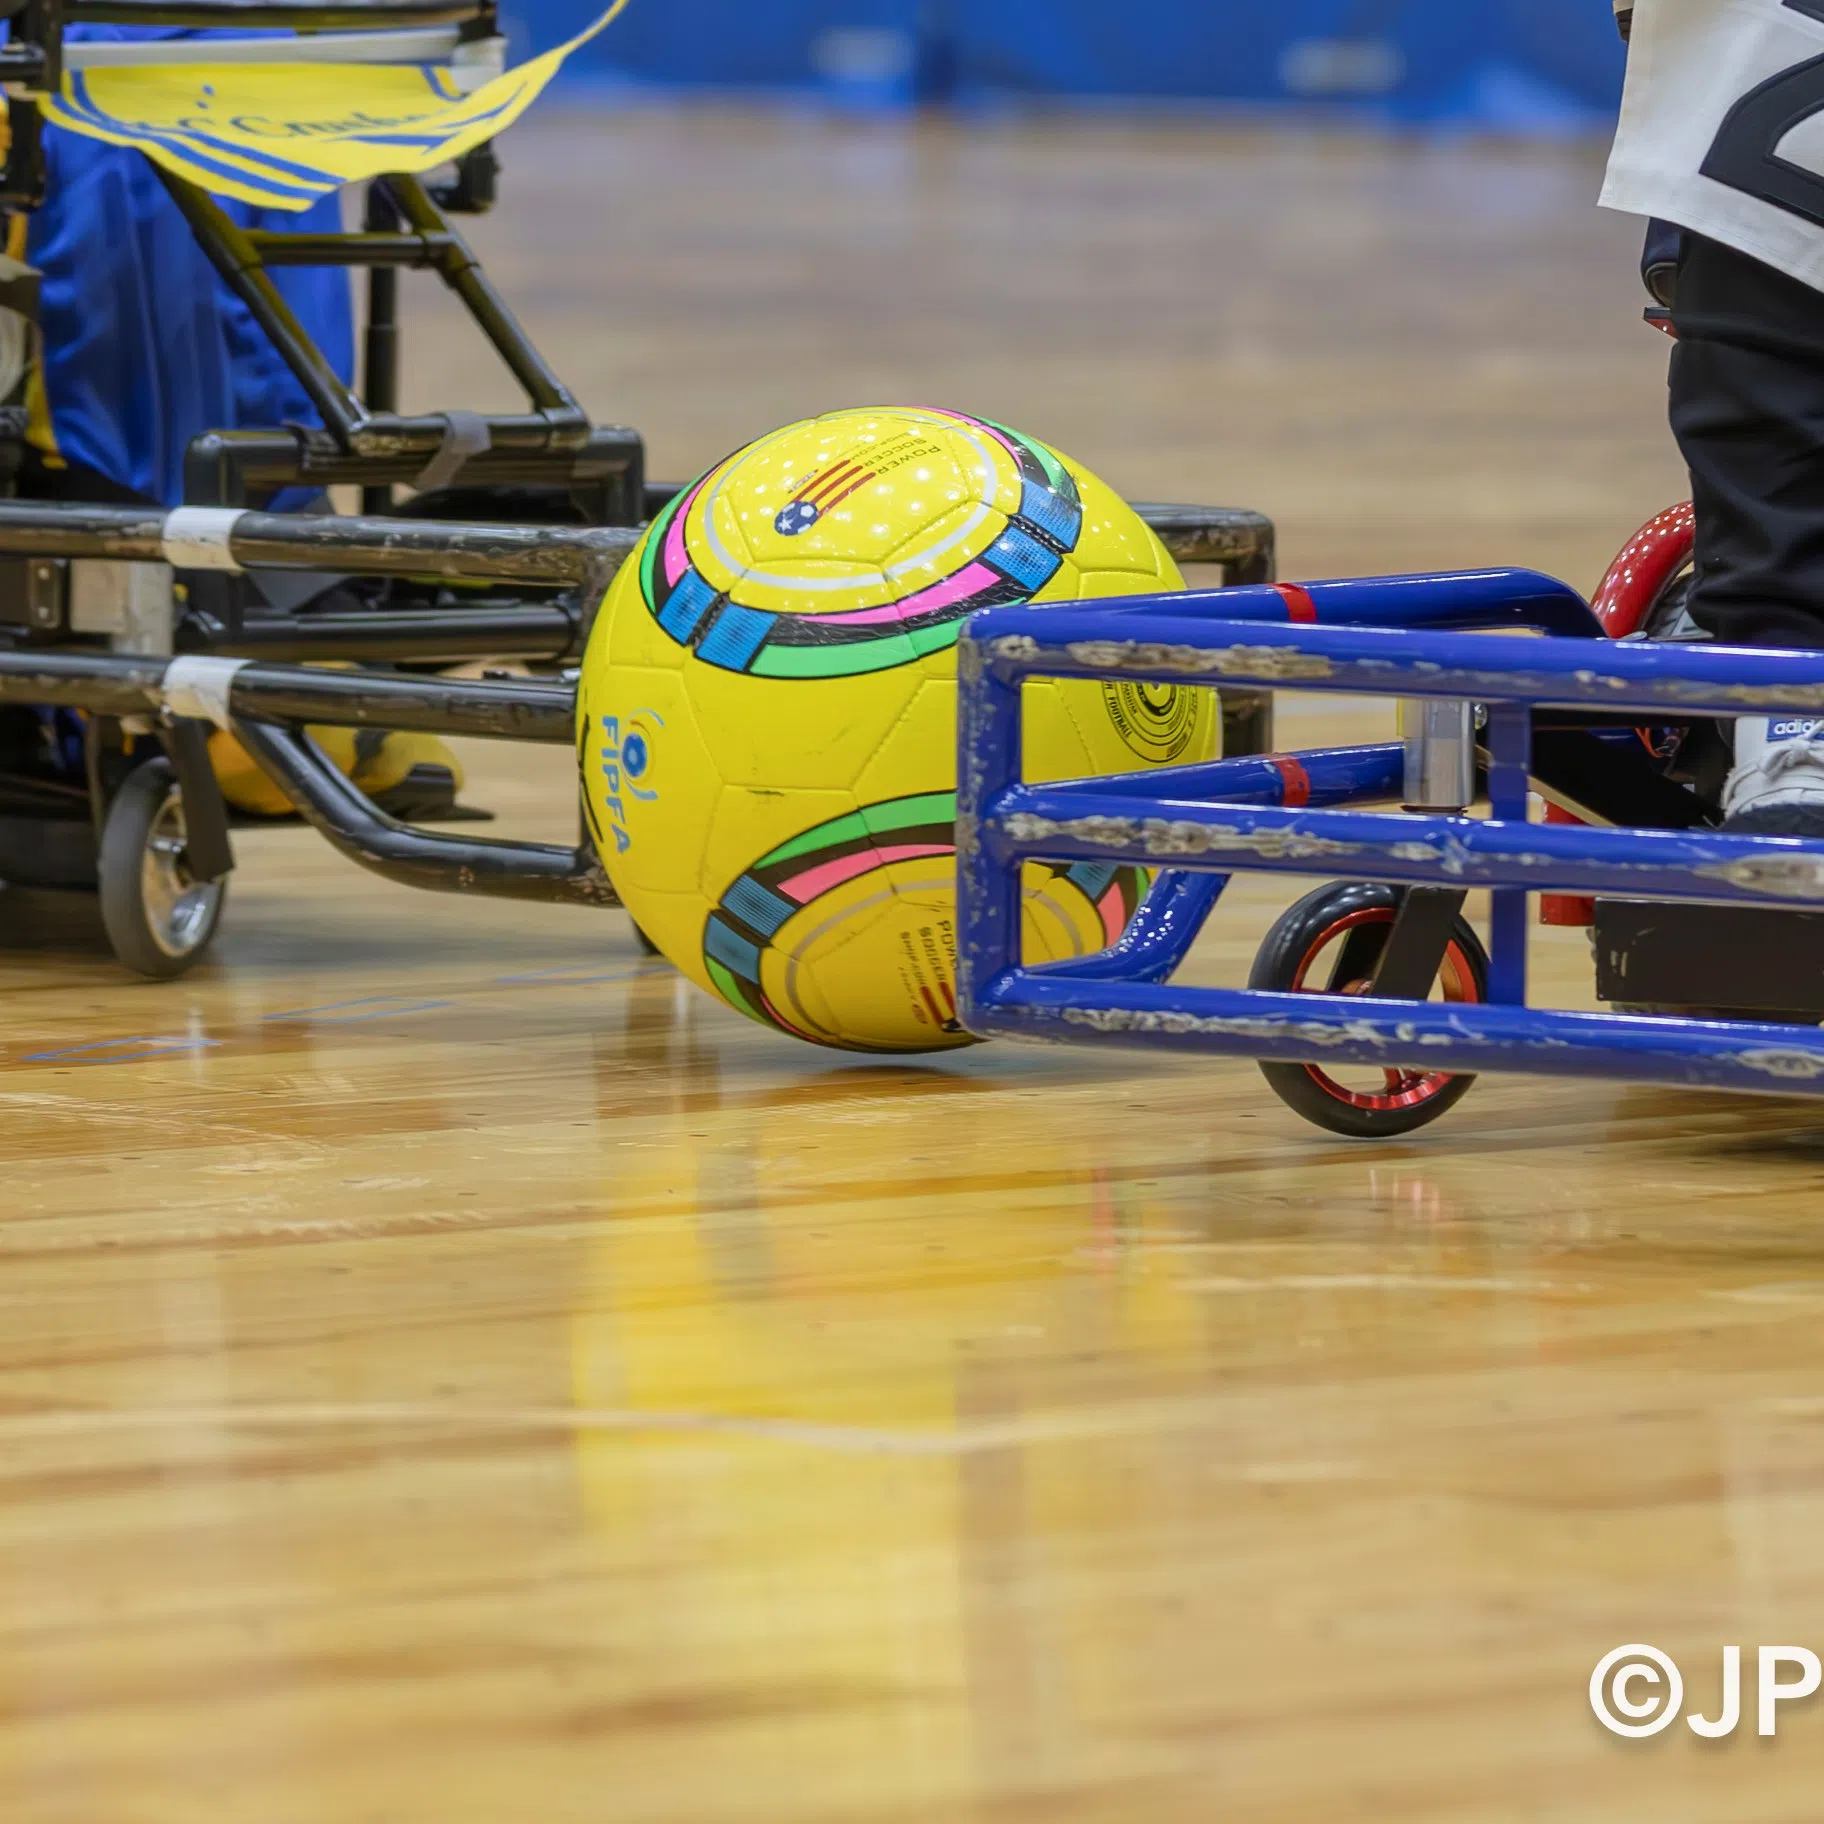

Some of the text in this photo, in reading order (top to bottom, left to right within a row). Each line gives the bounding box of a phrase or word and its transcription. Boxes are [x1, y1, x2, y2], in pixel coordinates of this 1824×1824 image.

[862, 437, 927, 467] SOCCER
[877, 444, 941, 475] POWER
[601, 715, 631, 855] FIPFA
